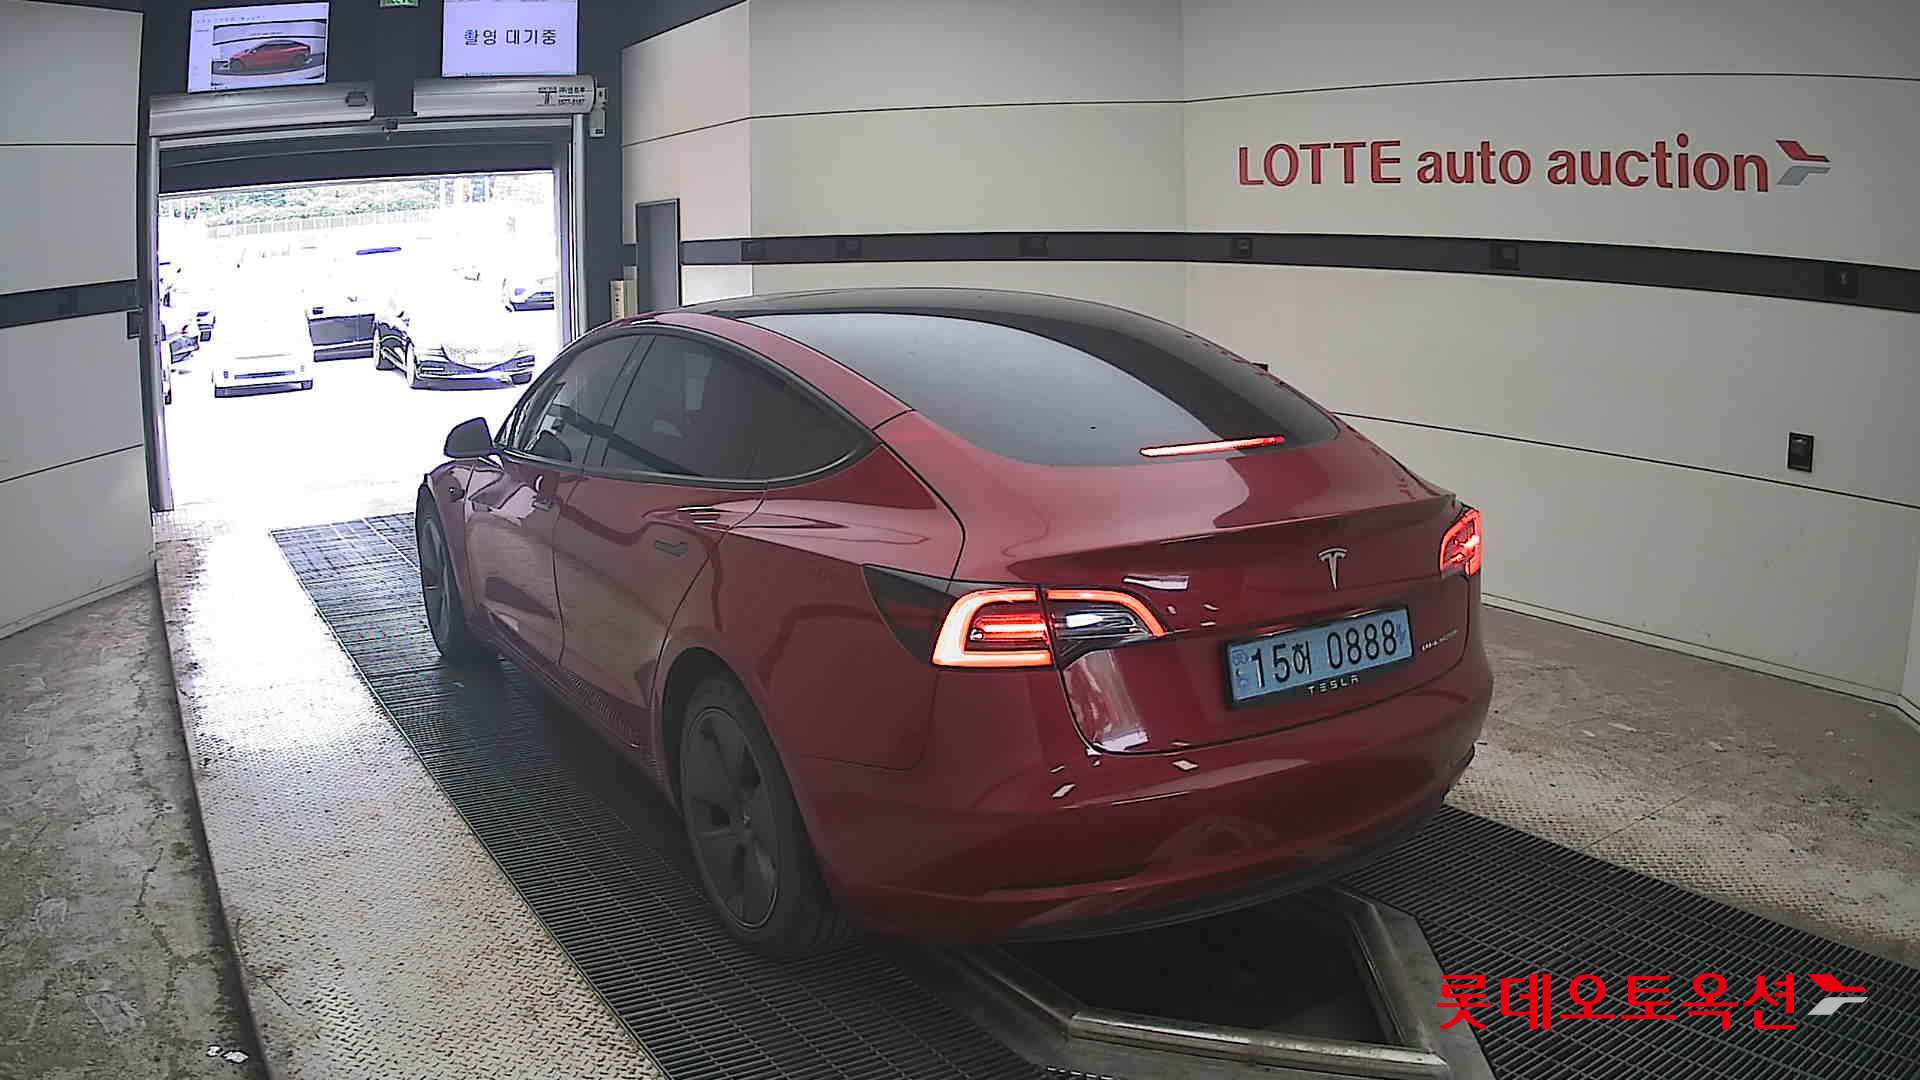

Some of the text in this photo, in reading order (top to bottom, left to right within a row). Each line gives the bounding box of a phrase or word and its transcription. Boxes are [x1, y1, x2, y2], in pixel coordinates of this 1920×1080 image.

[505, 28, 557, 46] 대기중
[1239, 133, 1770, 193] LOTTE auto auction
[1250, 640, 1313, 689] 15허
[1327, 619, 1398, 670] 0888
[1307, 674, 1361, 697] TESLA
